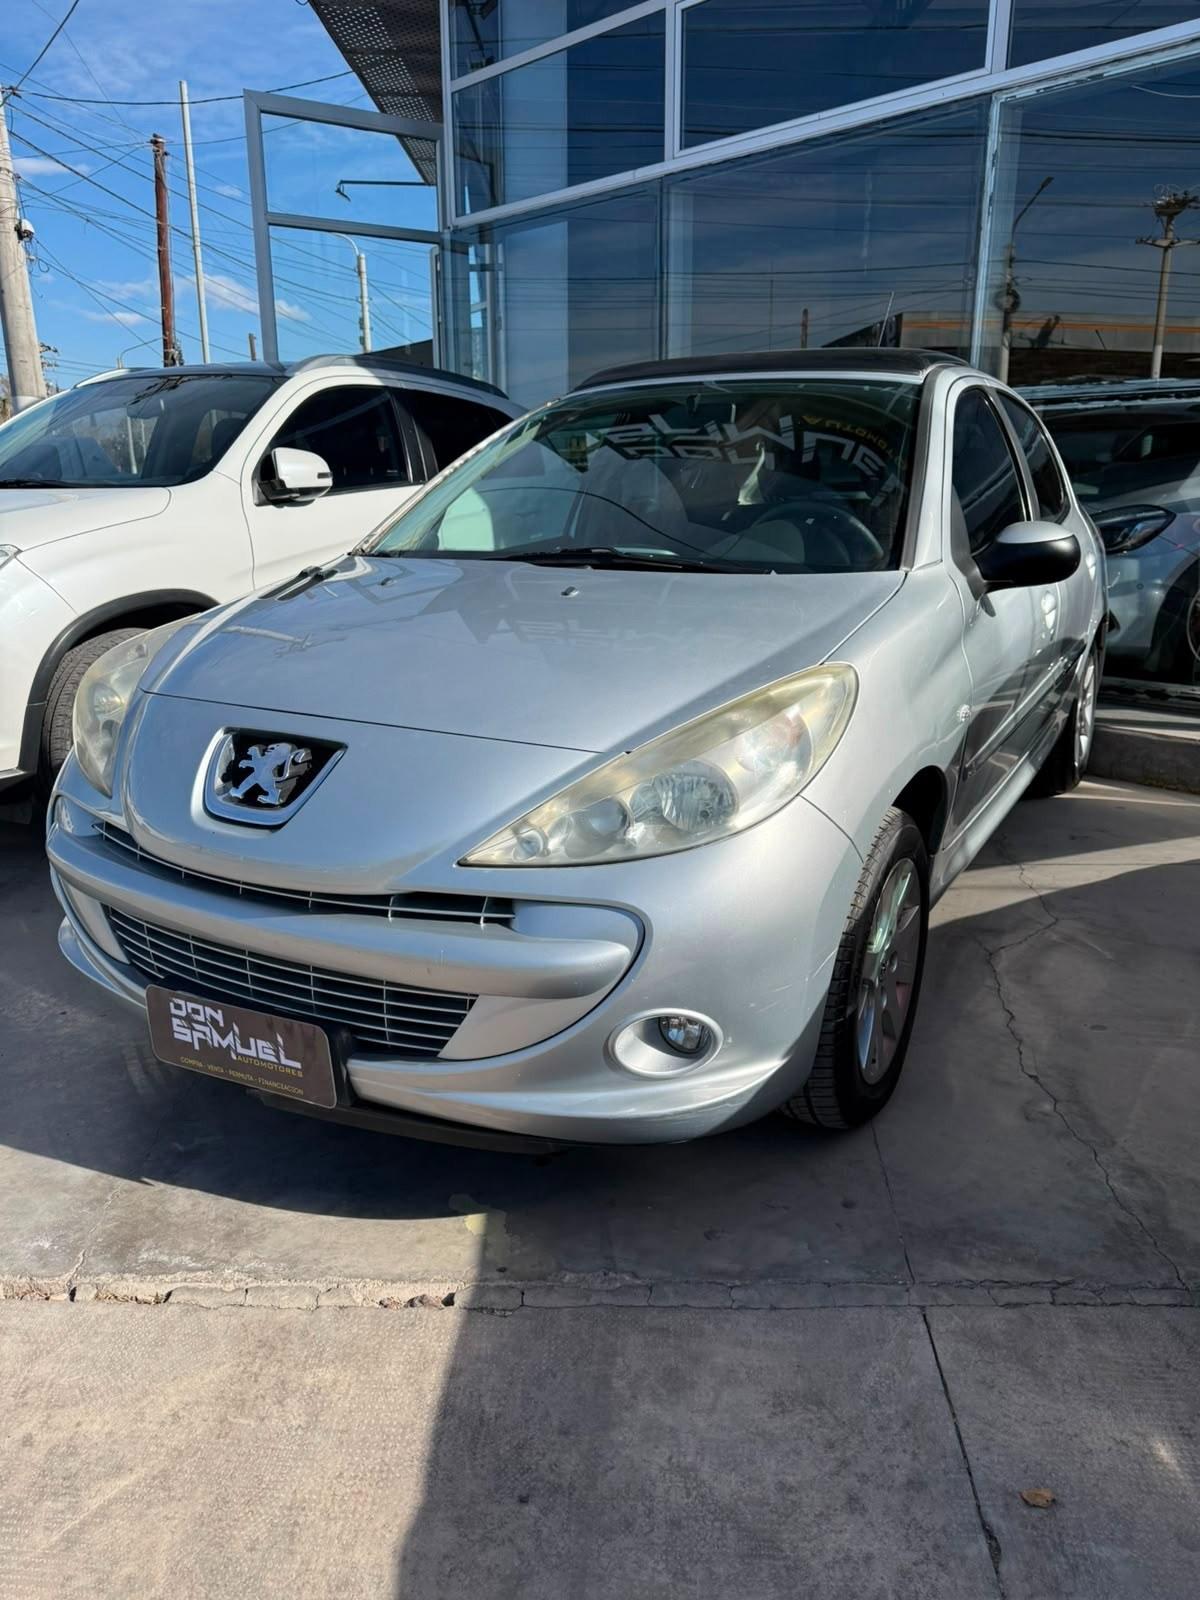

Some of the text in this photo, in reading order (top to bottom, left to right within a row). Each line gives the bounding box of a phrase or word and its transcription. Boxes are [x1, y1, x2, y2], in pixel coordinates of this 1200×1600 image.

[169, 998, 225, 1028] DON
[171, 1017, 302, 1069] SAMUEL
[237, 1056, 303, 1078] AUTOMOTORES
